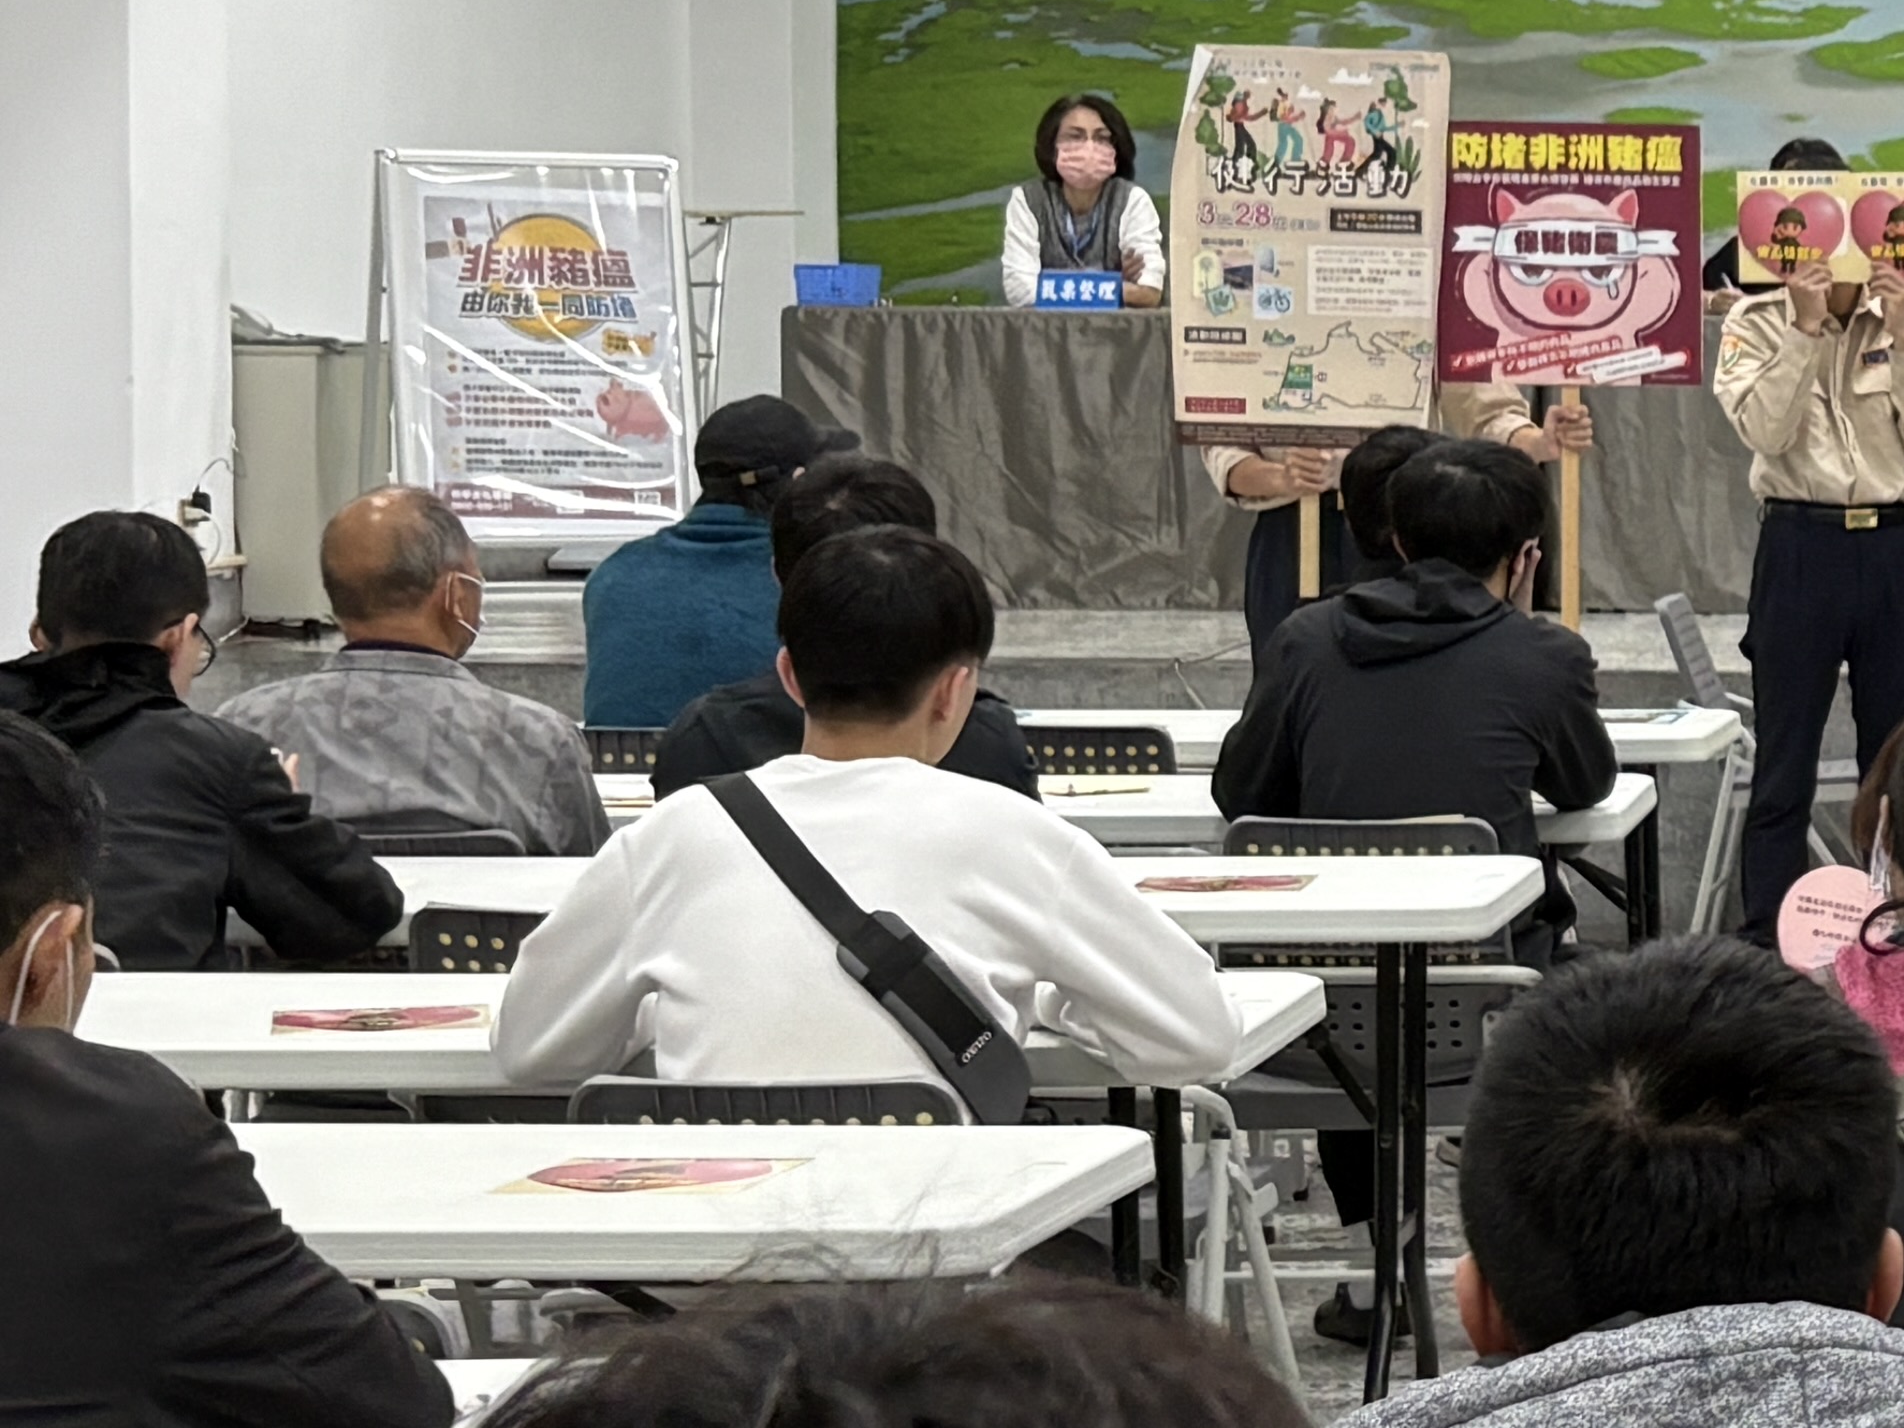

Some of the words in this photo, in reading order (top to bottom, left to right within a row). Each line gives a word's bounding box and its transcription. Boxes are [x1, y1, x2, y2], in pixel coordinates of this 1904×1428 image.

[1452, 132, 1684, 172] 防堵非洲豬瘟
[1211, 155, 1411, 196] 健行活動
[457, 238, 637, 289] 非洲豬瘟
